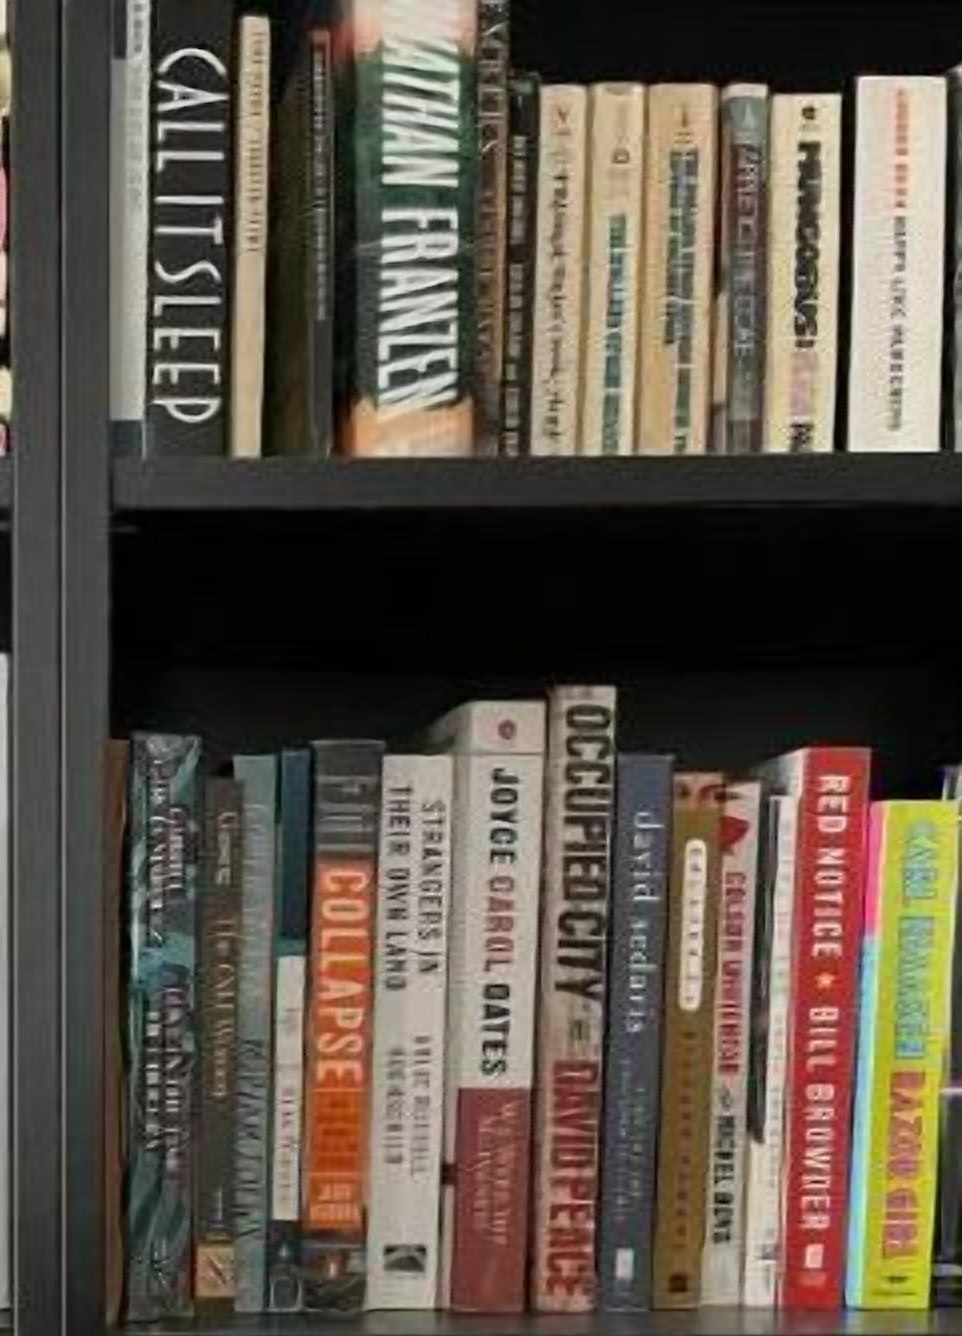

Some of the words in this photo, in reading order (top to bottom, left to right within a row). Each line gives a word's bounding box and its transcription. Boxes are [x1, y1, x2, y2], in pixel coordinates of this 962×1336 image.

[156, 47, 230, 173] CALL
[154, 194, 225, 245] IT
[149, 259, 223, 424] SLEEP
[377, 207, 460, 423] FRANZEN
[386, 786, 412, 857] THEIR
[490, 767, 520, 865] JOYCE
[553, 703, 613, 899] OCCUPIED
[816, 774, 849, 834] RED
[386, 867, 411, 921] OWN
[417, 799, 445, 940] STRANGERS
[629, 808, 665, 903] david
[812, 847, 846, 959] NOTICE
[317, 866, 370, 1086] COLLAPSE
[487, 875, 517, 973] CAROL
[551, 908, 606, 1002] CITY
[482, 982, 513, 1077] OATES
[807, 1006, 840, 1075] BILL
[548, 1059, 599, 1171] DAVID
[802, 1083, 836, 1231] BROWDER
[545, 1181, 597, 1298] PEACE
